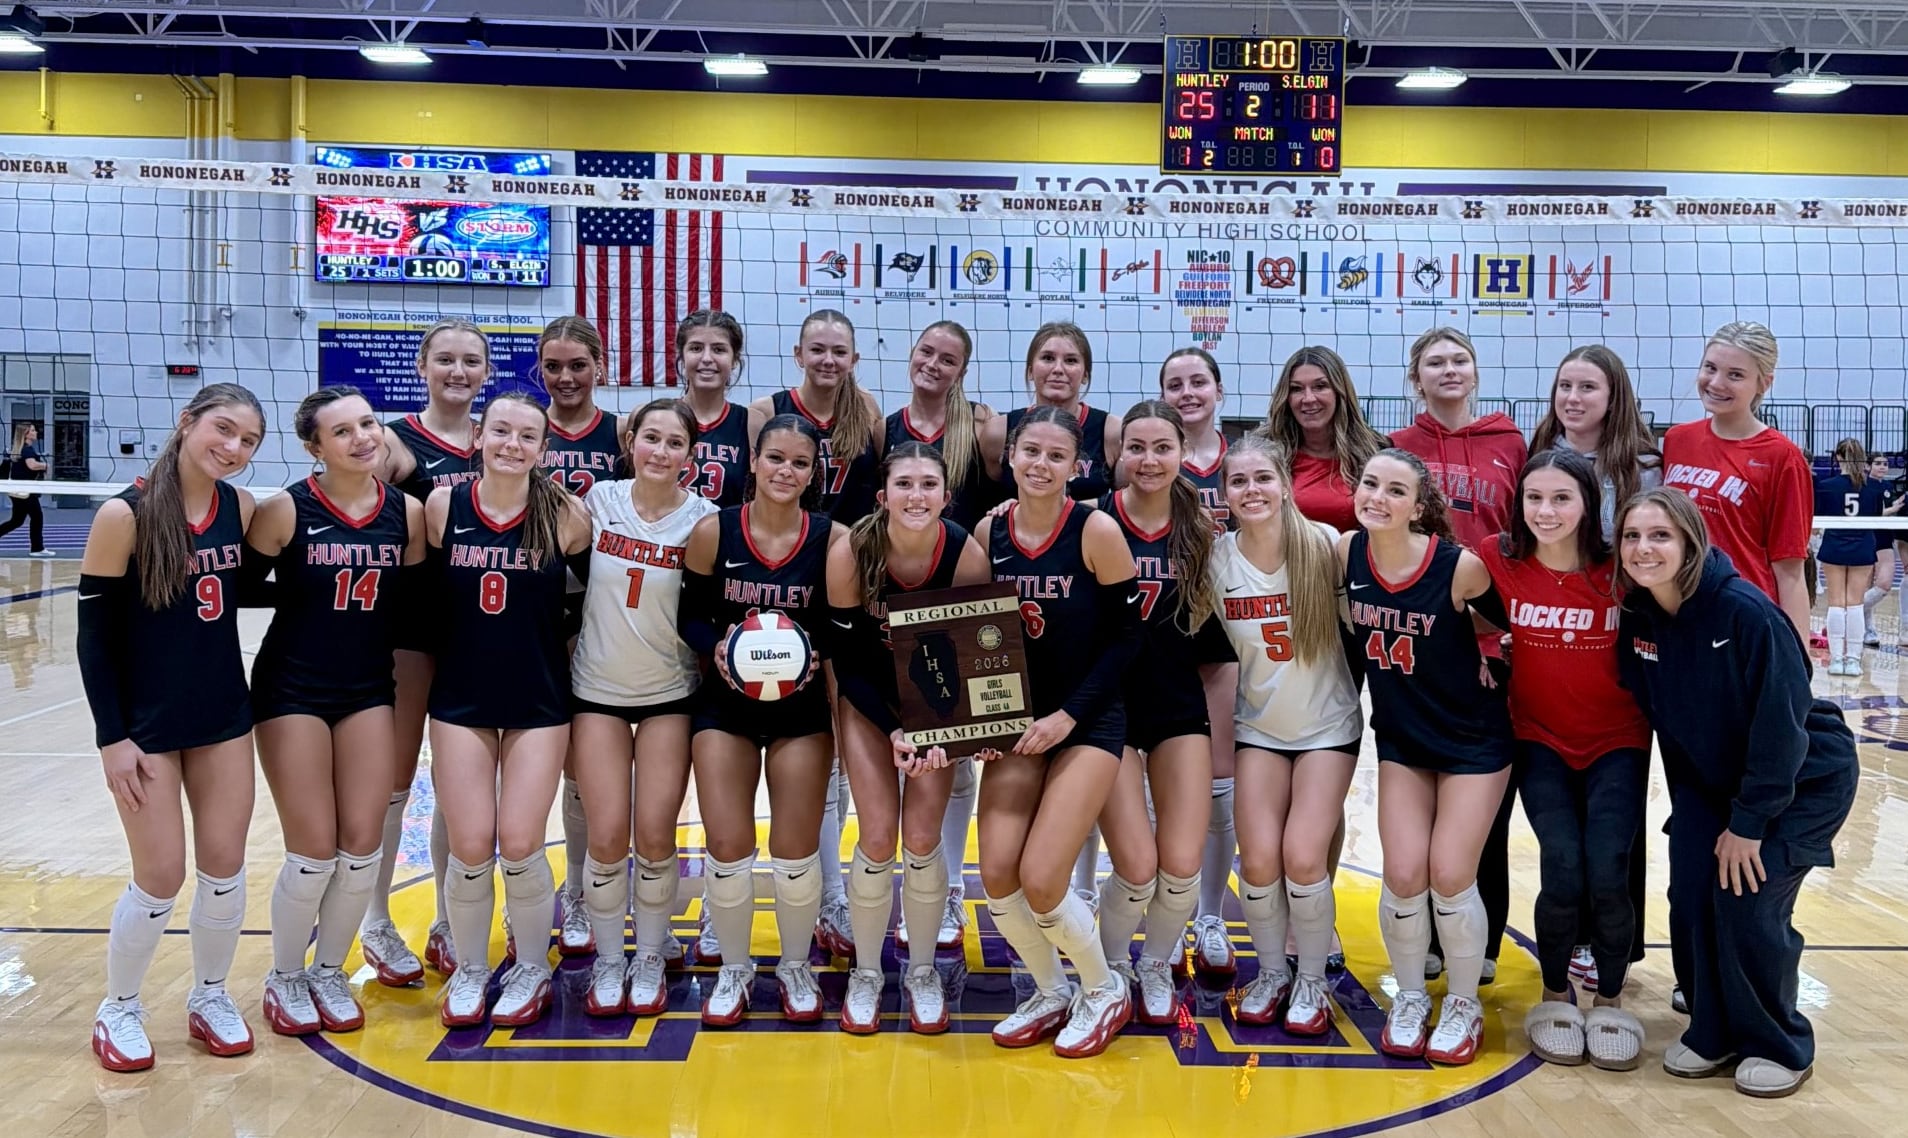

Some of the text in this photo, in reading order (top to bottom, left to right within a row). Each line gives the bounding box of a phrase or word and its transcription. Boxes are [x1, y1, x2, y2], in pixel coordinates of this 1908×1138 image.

[1244, 41, 1295, 68] 1:00
[1176, 74, 1230, 87] HUNTLEY
[1238, 82, 1270, 92] PERIOD
[1282, 75, 1328, 88] S.ELGIN
[1179, 91, 1214, 119] 25
[1246, 95, 1260, 117] 2
[1311, 95, 1335, 119] 11
[1169, 126, 1192, 139] WON
[1234, 127, 1273, 140] MATCH
[1312, 128, 1335, 141] WON
[1203, 150, 1214, 166] 2
[1320, 147, 1333, 168] 0
[140, 165, 246, 181] HONONEGAH
[316, 172, 421, 189] HONONEGAH
[492, 179, 596, 197] HONONEGAH
[665, 187, 766, 203] HONONEGAH
[834, 192, 935, 208] HONONEGAH
[1002, 197, 1102, 212] HONONEGAH
[1169, 200, 1270, 215] HONONEGAH
[1337, 202, 1439, 216] HONONEGAH
[1506, 202, 1609, 216] HONONEGAH
[1675, 202, 1777, 216] HONONEGAH
[336, 210, 400, 240] HHS
[419, 208, 447, 231] VS
[464, 221, 531, 234] STORM
[1035, 219, 1372, 241] COMMUNITY HIGH SCHOOL
[327, 256, 372, 265] HUNTLEY
[331, 266, 346, 277] 25
[412, 260, 460, 278] 1:00
[374, 269, 399, 278] SETS
[522, 271, 538, 282] 11
[1183, 272, 1230, 281] GUILFORD
[1486, 259, 1523, 293] H
[1179, 281, 1230, 289] FREEPORT
[1210, 290, 1231, 298] NORTH
[1177, 299, 1230, 307] HONONEGAH
[338, 312, 400, 321] HONONEGAH
[492, 316, 533, 324] SCHOOL
[1191, 324, 1225, 332] HARLEM
[1192, 332, 1222, 341] BOYLAN
[537, 450, 615, 472] UNTLEY
[676, 461, 725, 500] 23
[1844, 493, 1860, 516] 5
[186, 543, 242, 575] NTLEY
[308, 543, 402, 567] HUNTLEY
[450, 543, 544, 571] HUNTLEY
[597, 529, 687, 570] HUNTLEY
[196, 574, 224, 622] 9
[333, 569, 381, 610] 14
[479, 571, 508, 615] 8
[626, 568, 646, 609] 1
[724, 577, 814, 608] HUNTLEY
[1137, 580, 1163, 621] 7
[904, 601, 1003, 623] REGIONAL
[1019, 600, 1046, 639] 6
[1351, 599, 1436, 637] HUNTLEY
[1510, 598, 1595, 631] LOCKED
[1260, 621, 1294, 663] 5
[1365, 630, 1415, 675] 44
[750, 649, 791, 661] Wilson
[975, 654, 1010, 671] 2026
[980, 689, 1013, 701] VOLLEYBALL
[987, 679, 1003, 690] GIRLS
[985, 703, 1001, 713] CLASS
[911, 719, 1029, 744] CHAMPIONS
